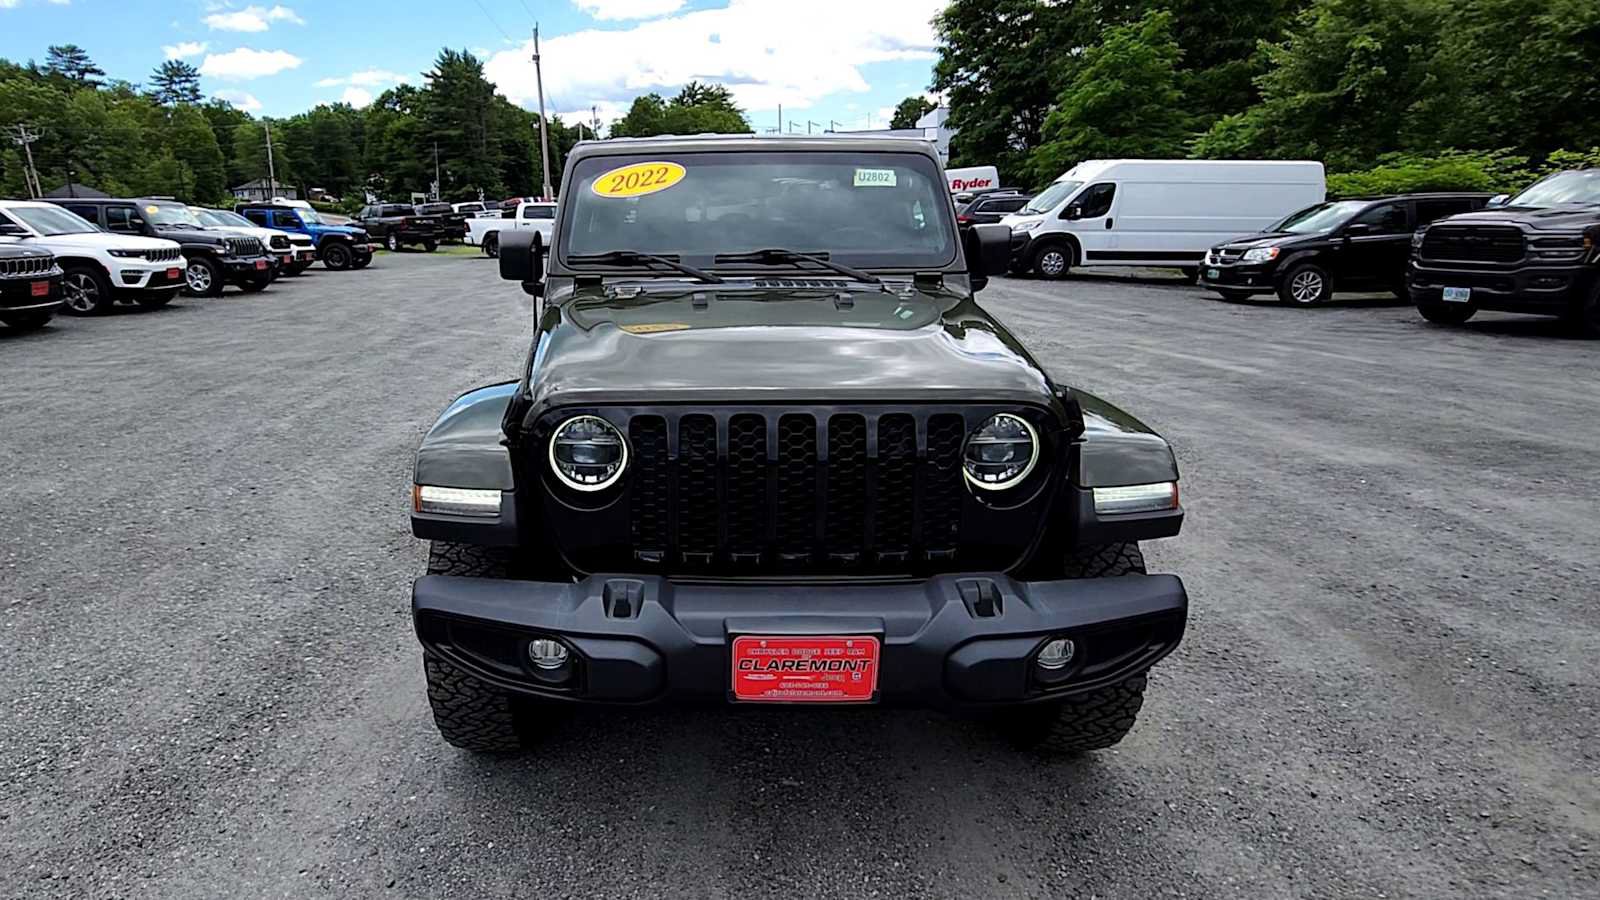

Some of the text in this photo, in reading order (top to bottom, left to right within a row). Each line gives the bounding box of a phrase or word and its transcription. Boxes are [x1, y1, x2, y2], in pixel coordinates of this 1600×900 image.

[609, 167, 669, 192] 2022
[858, 170, 889, 181] U2802
[952, 178, 992, 190] Ryder
[738, 658, 871, 672] CLAREMONT
